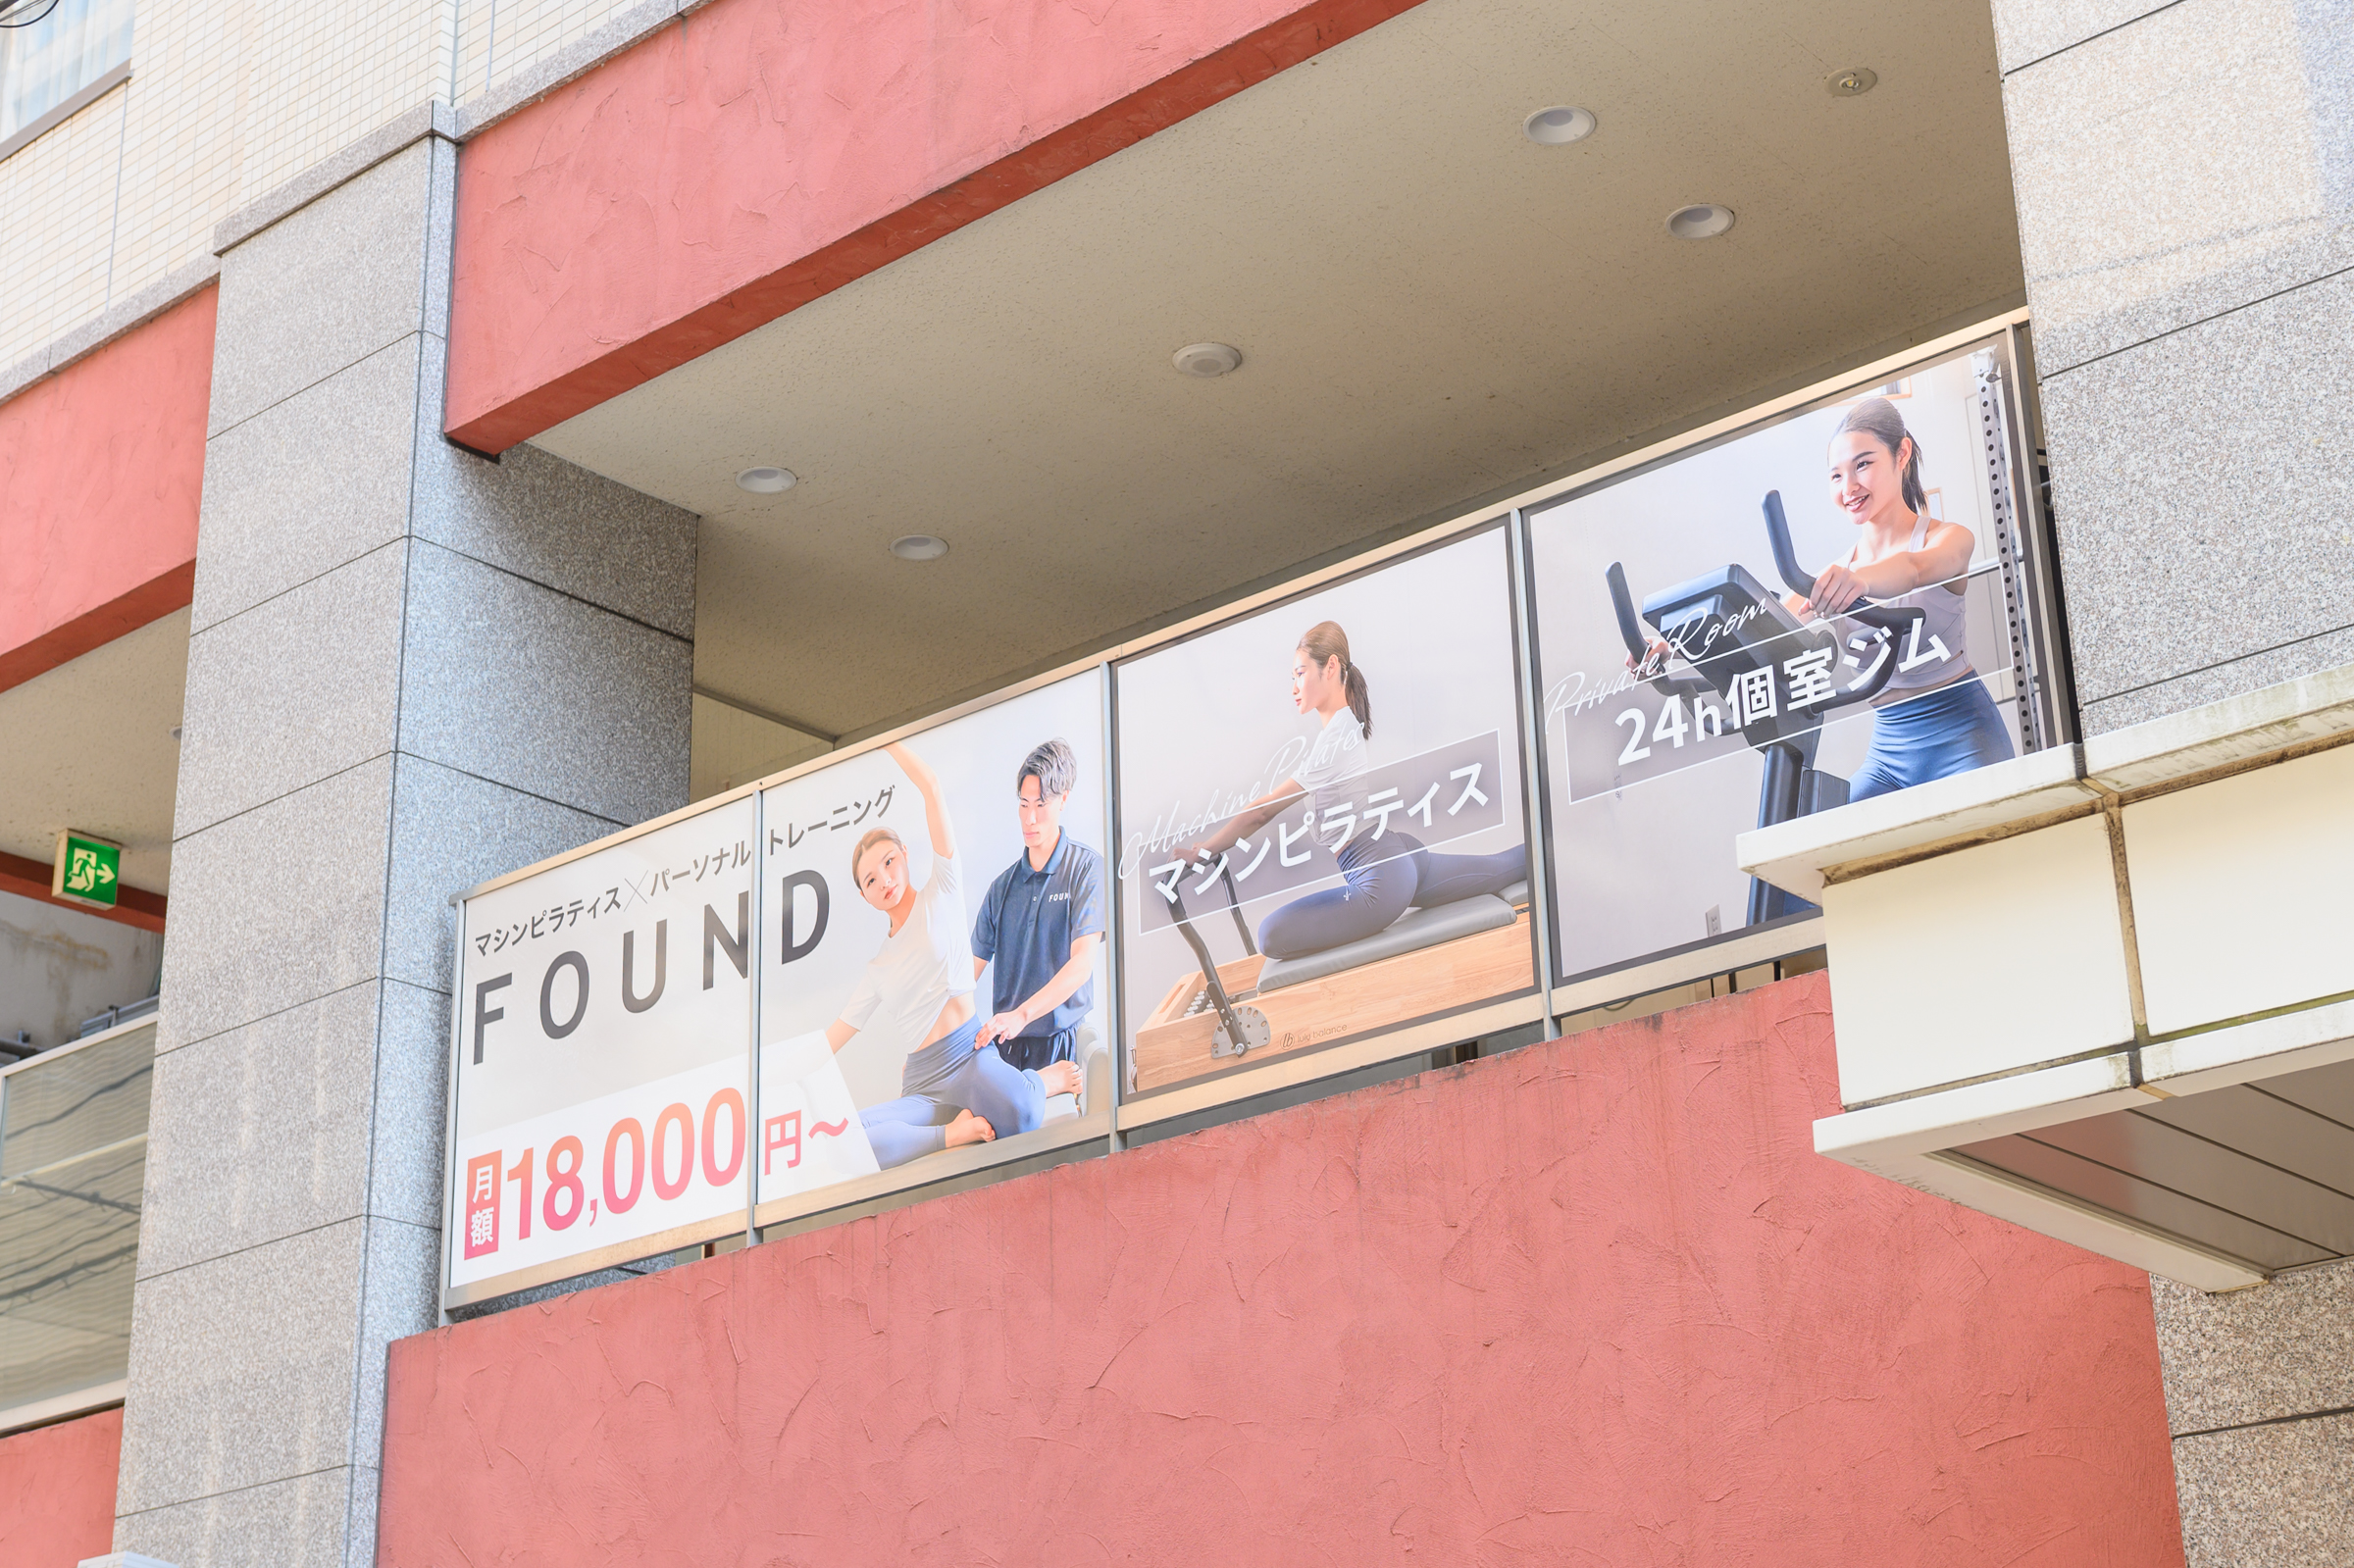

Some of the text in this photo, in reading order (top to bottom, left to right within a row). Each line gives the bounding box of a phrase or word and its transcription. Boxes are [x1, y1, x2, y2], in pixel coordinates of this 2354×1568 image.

[1544, 598, 1767, 734] Private Room
[1614, 617, 1952, 766] 24h個室ジム
[1118, 722, 1365, 880] Machine Pilates
[1149, 762, 1490, 904] マシンピラティス
[473, 869, 831, 1066] FOUND
[1297, 1033, 1311, 1043] lulu
[1312, 1023, 1348, 1038] balance
[470, 1164, 494, 1248] 月額
